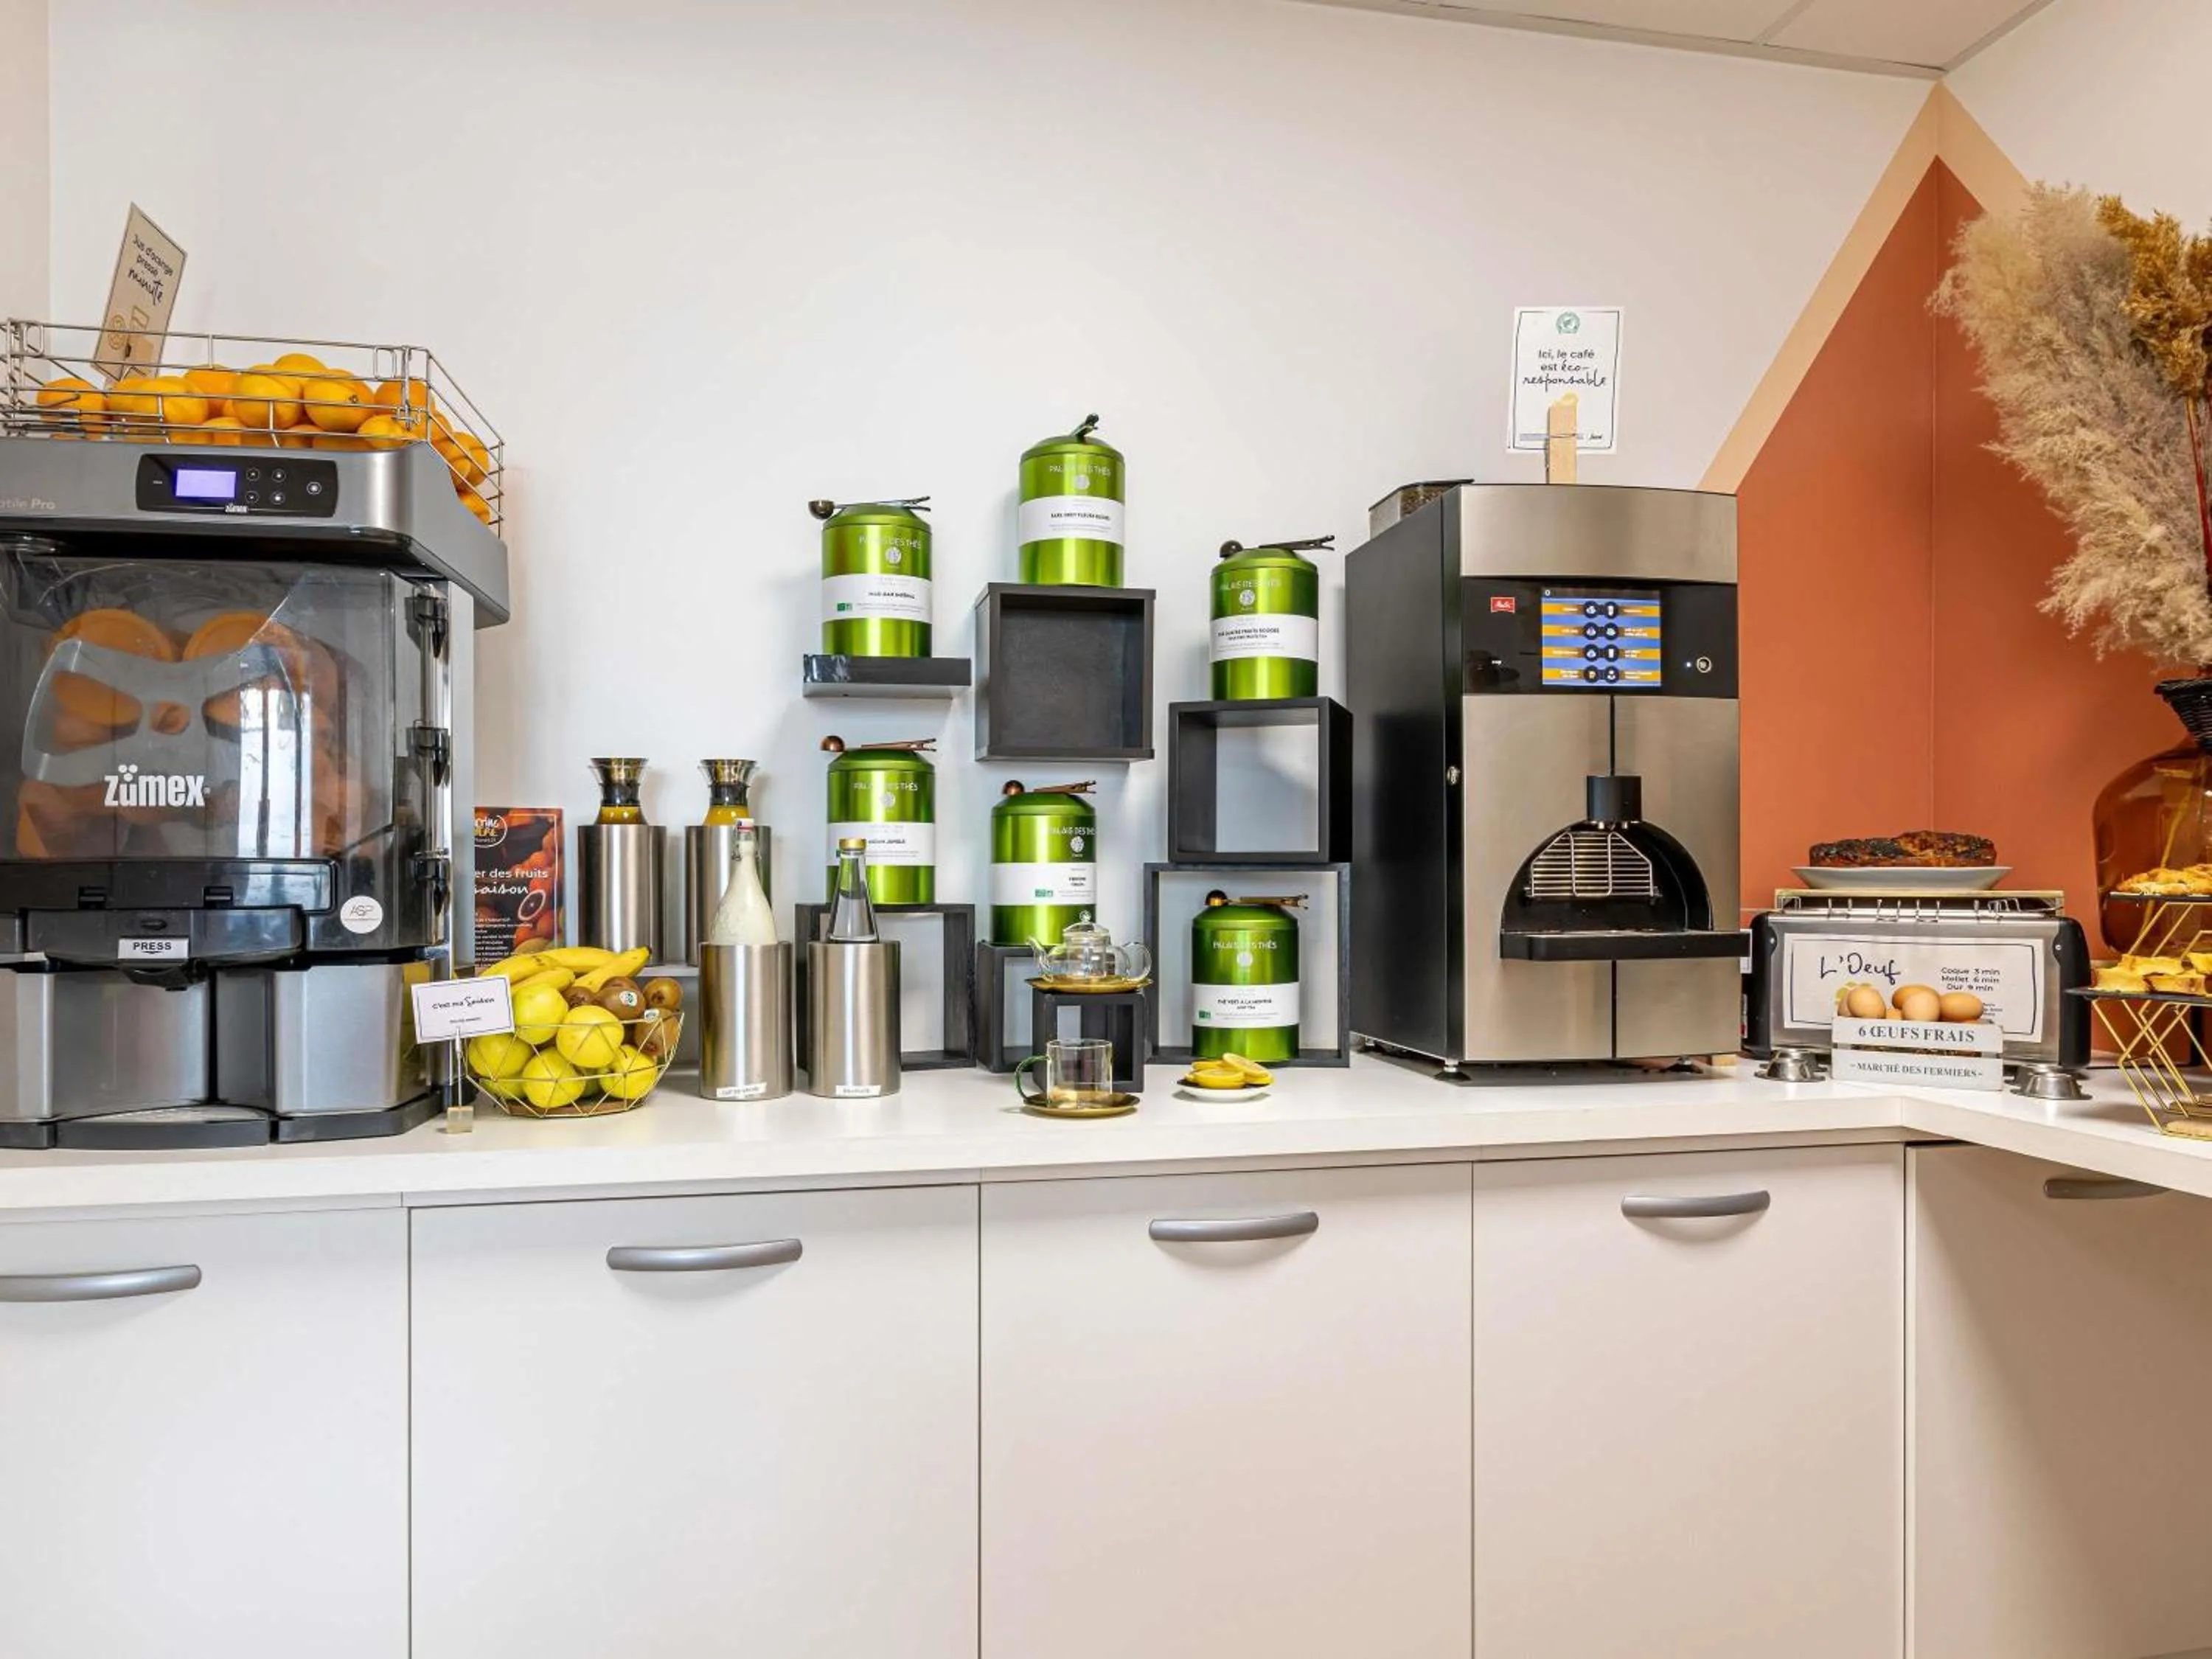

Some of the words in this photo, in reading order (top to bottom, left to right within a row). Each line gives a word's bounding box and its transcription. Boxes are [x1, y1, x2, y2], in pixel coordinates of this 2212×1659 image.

[1538, 349, 1554, 360] Ici,
[1557, 349, 1568, 359] le
[1570, 349, 1595, 359] café
[1540, 364, 1557, 372] est
[1523, 369, 1607, 392] responsable
[490, 868, 512, 878] des
[515, 867, 549, 878] fruits
[133, 941, 173, 951] PRESS
[1941, 967, 1969, 975] Coque
[1858, 1026, 1867, 1037] 6
[1870, 1025, 1920, 1040] ŒUFS
[1923, 1029, 1975, 1043] FRAIS
[1856, 1062, 1900, 1074] MARCHÉ
[1901, 1065, 1921, 1074] DES
[1923, 1067, 1978, 1077] FERMIERS
